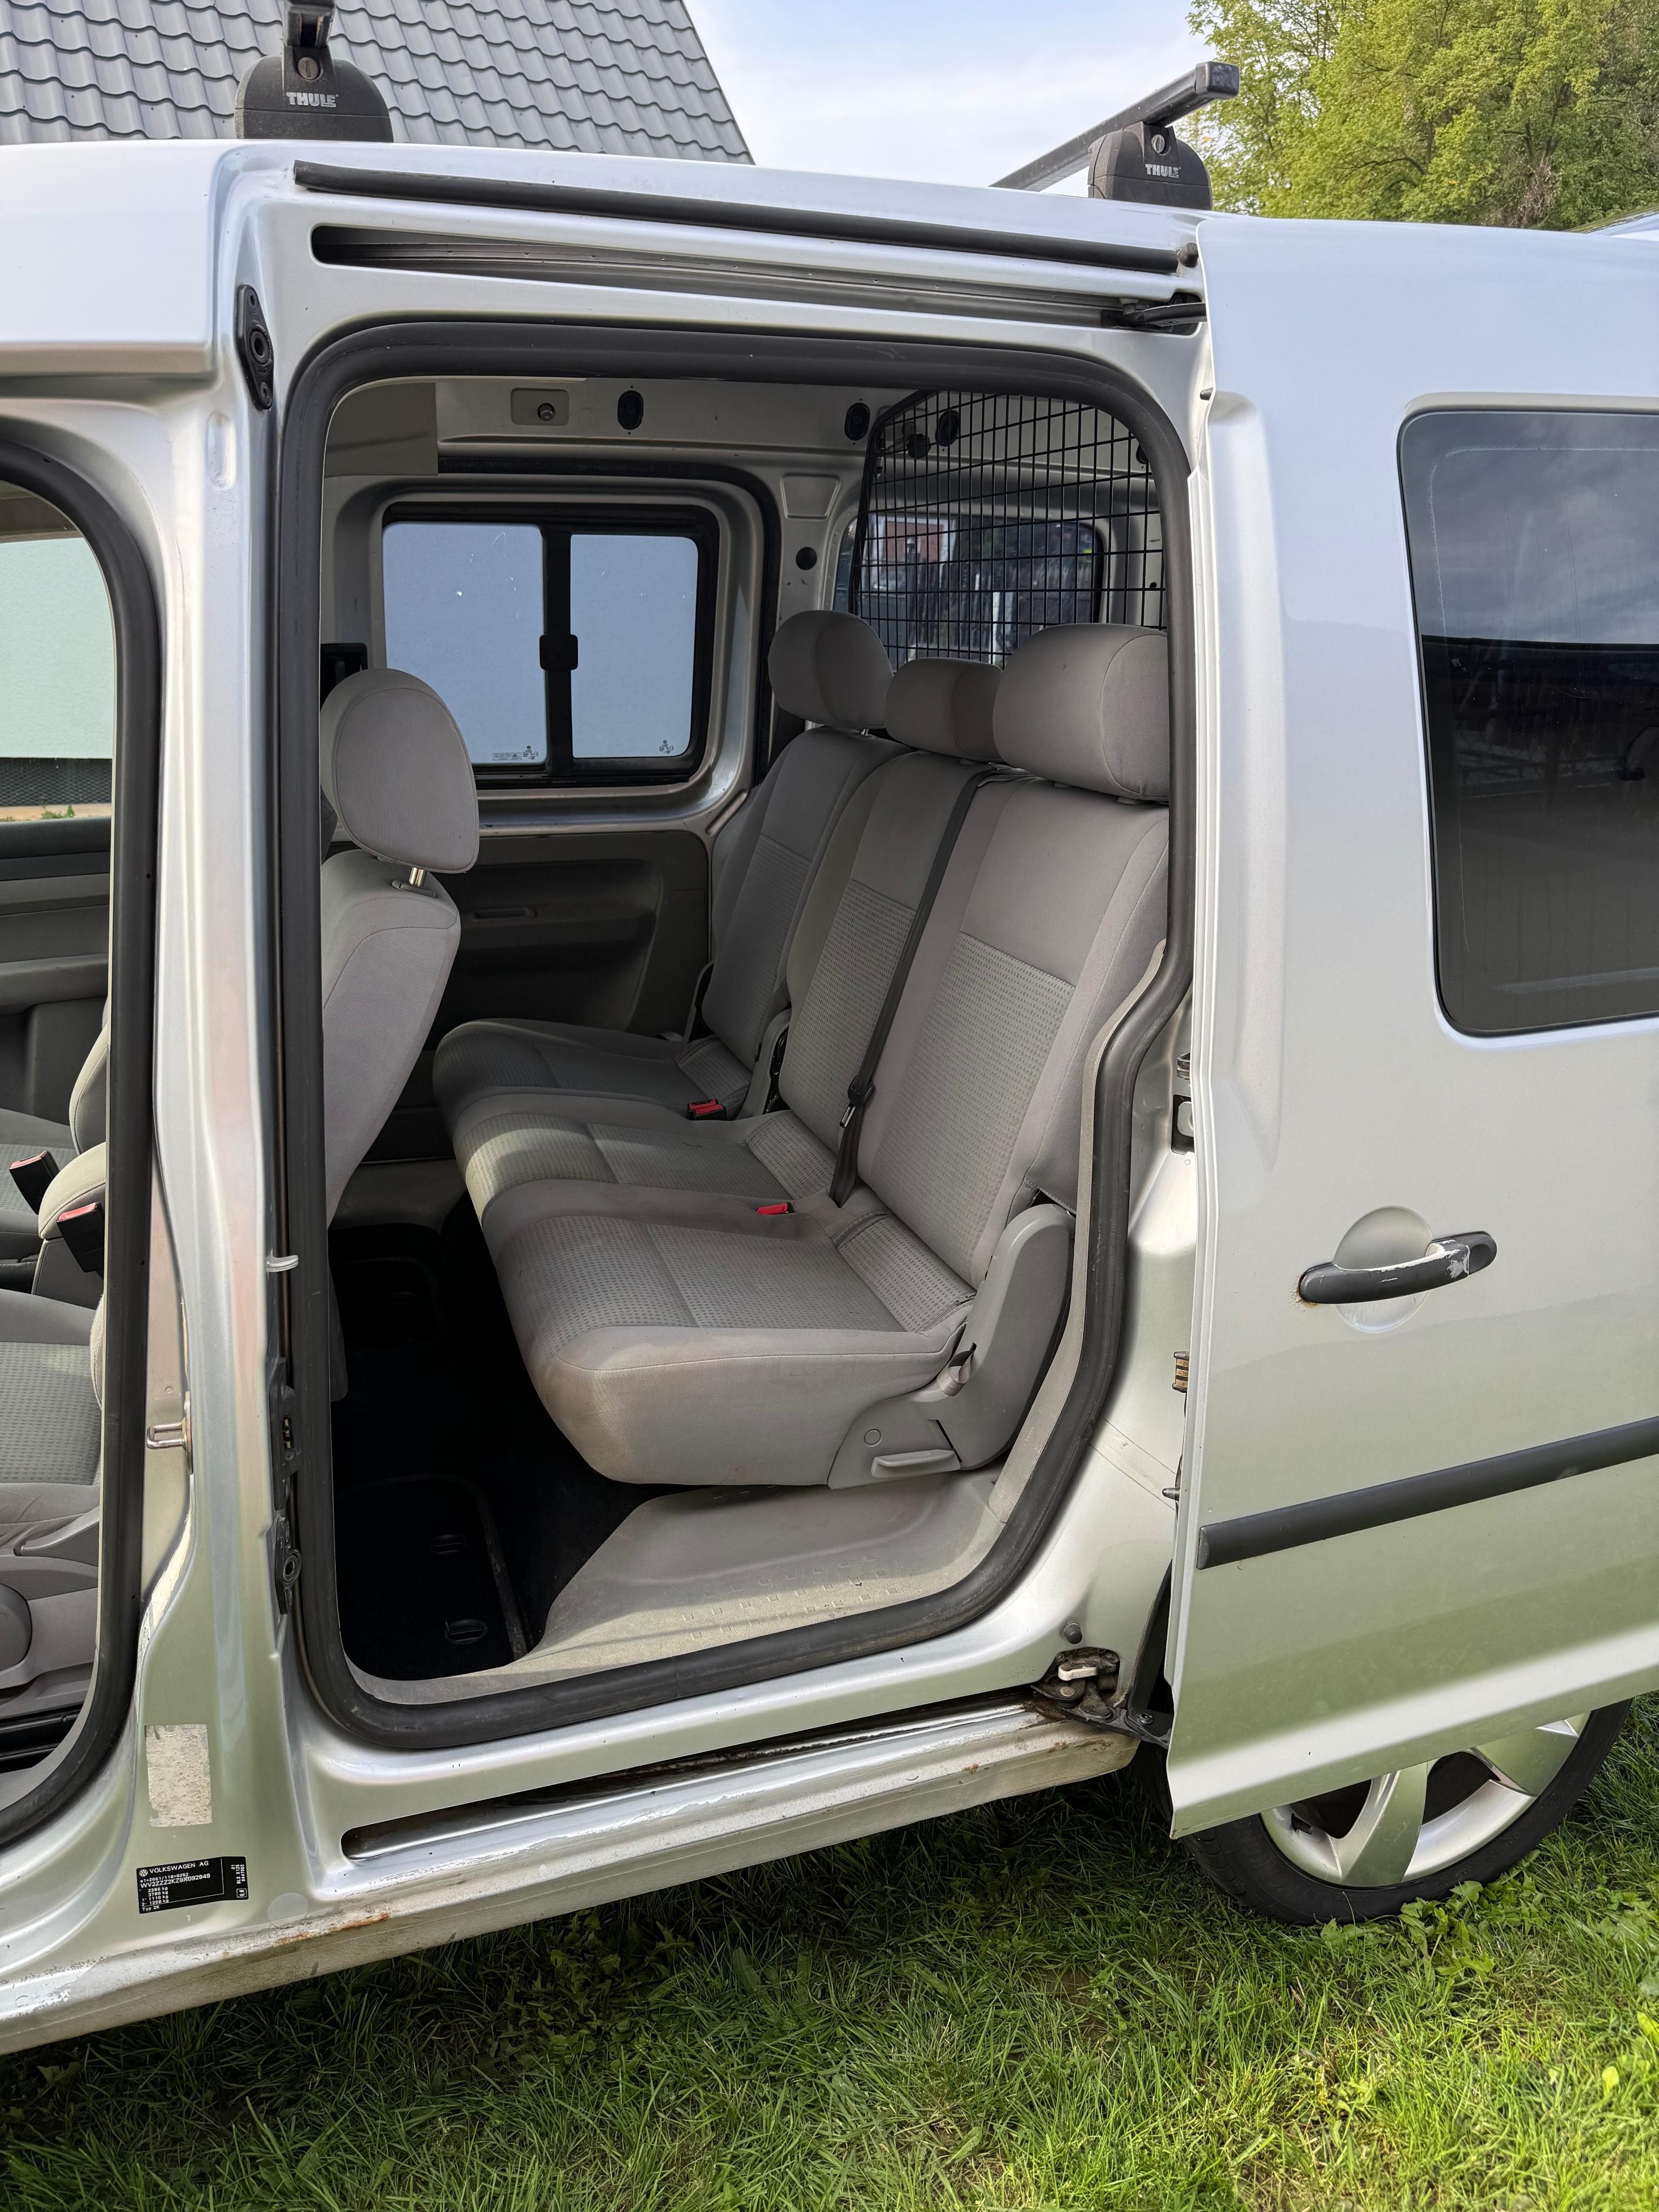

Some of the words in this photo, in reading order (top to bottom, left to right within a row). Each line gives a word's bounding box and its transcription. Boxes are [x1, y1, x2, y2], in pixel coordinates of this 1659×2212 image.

[286, 92, 336, 107] THULE
[1145, 164, 1179, 178] THULE
[150, 1863, 195, 1873] VOLKSWAGEN
